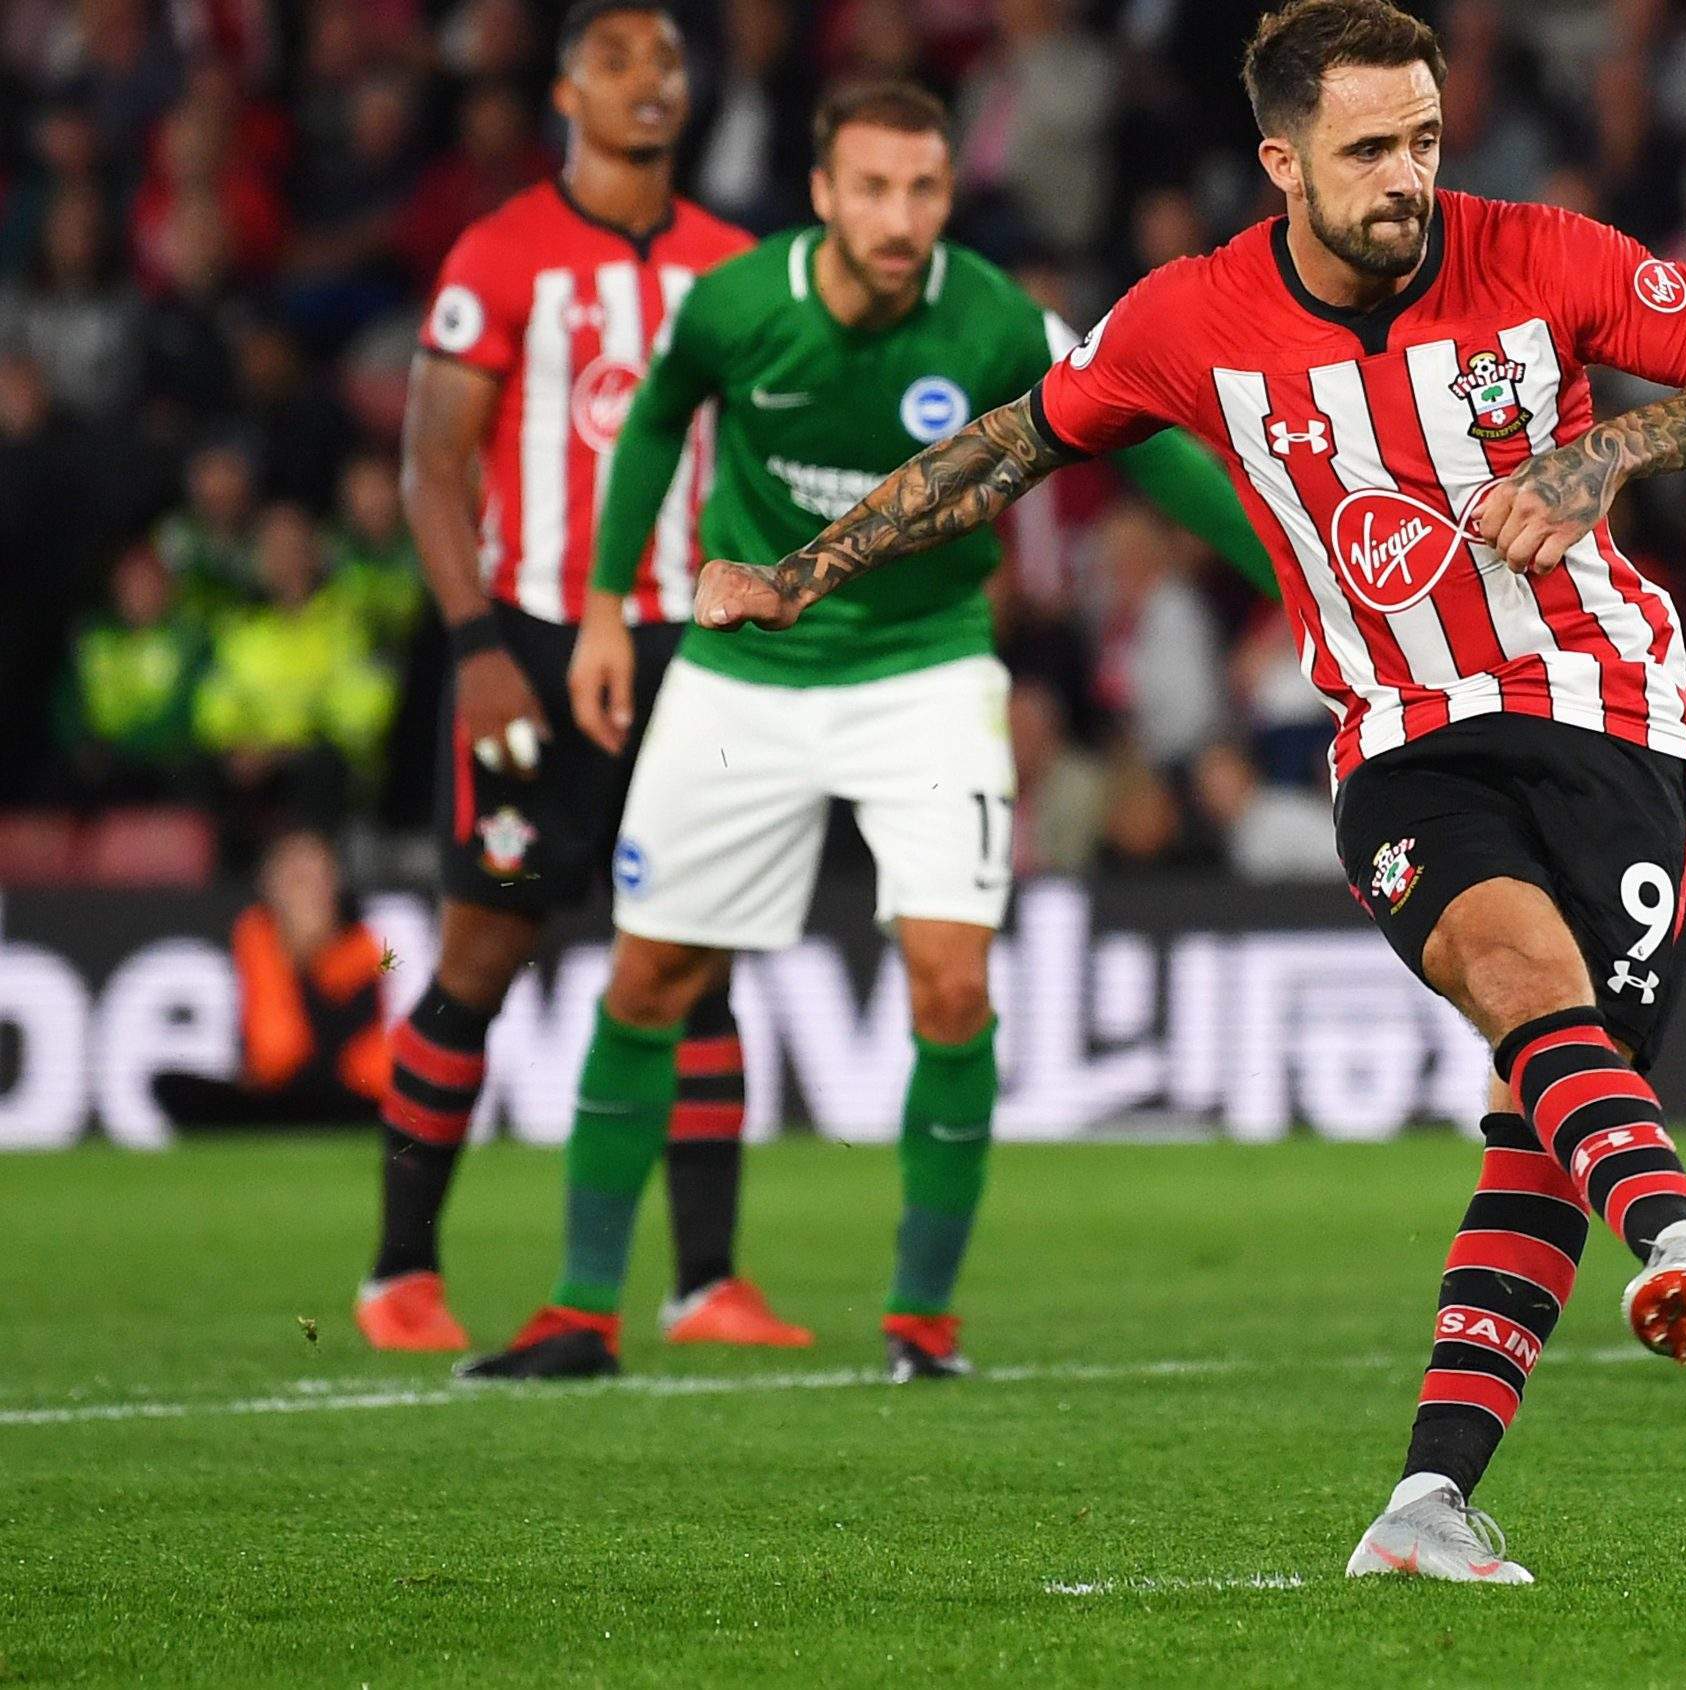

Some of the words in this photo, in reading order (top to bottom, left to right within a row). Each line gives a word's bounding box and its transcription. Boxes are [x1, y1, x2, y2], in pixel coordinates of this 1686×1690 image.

[1351, 511, 1433, 589] Virgin
[1620, 861, 1675, 962] 9
[1440, 1312, 1539, 1368] SAIN
